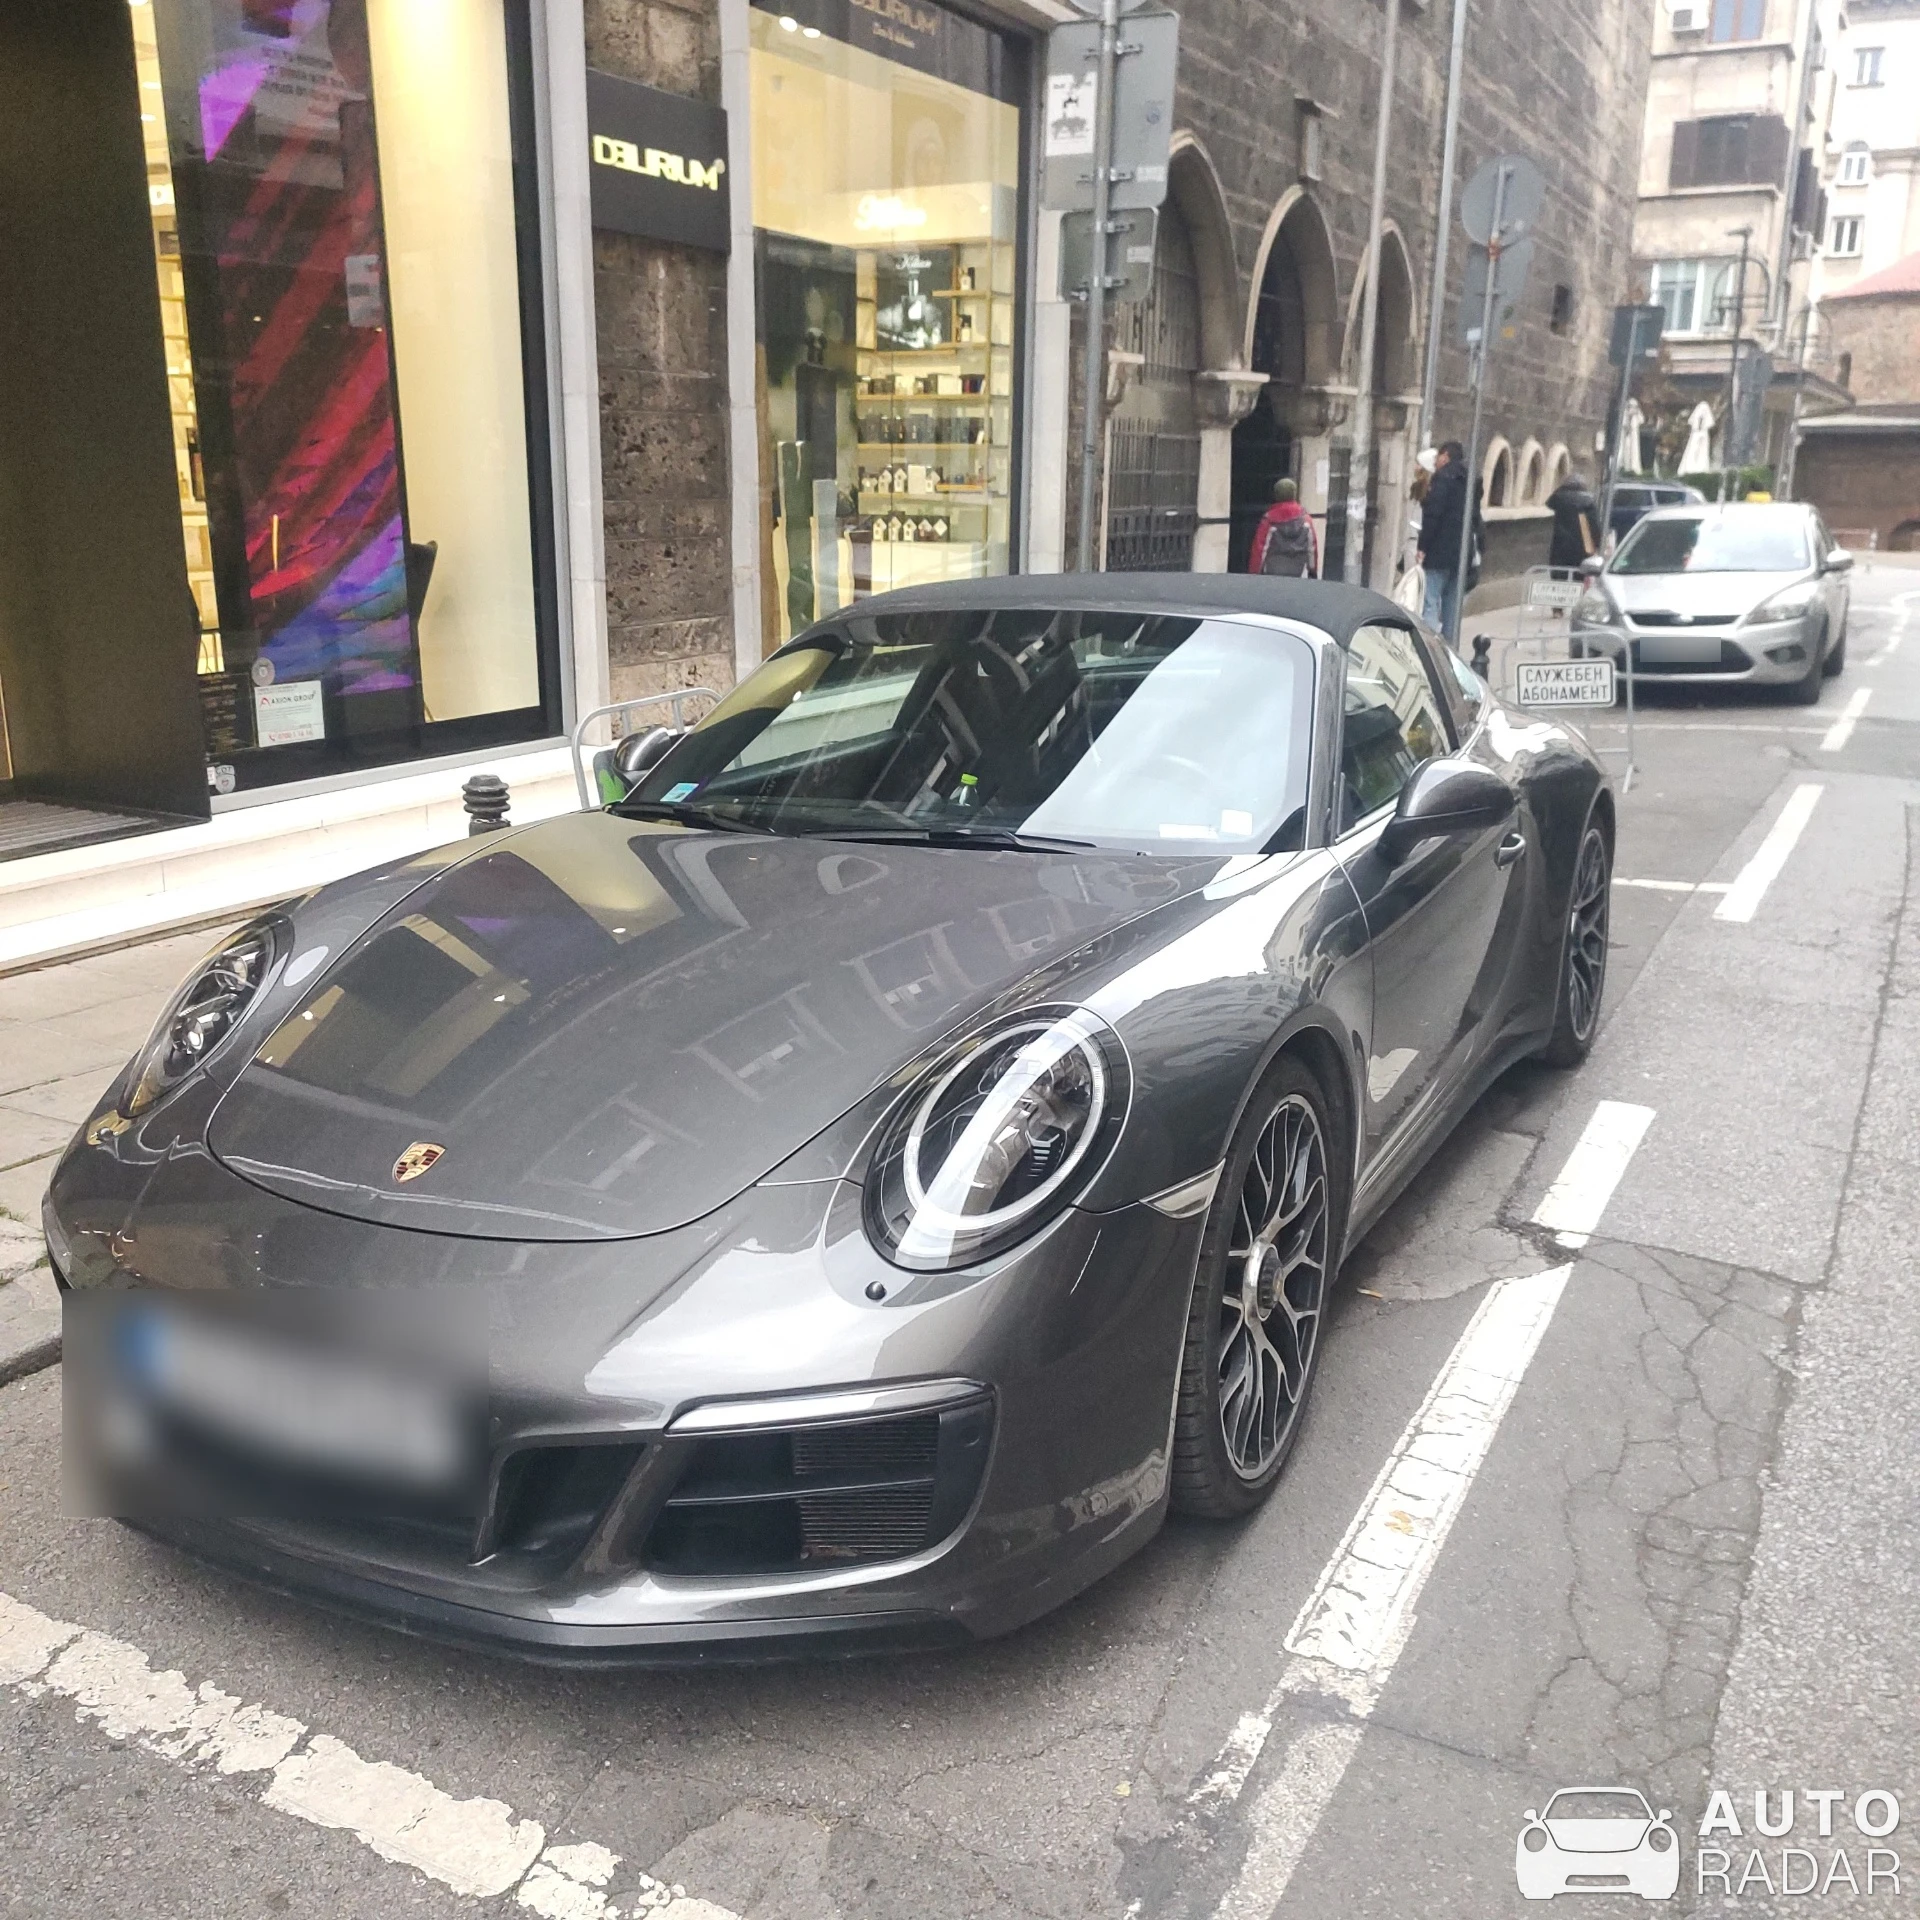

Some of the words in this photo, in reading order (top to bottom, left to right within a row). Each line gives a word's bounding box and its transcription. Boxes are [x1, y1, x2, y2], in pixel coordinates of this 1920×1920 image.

[849, 0, 938, 36] LIRIUM
[593, 134, 719, 191] DELIRIUM
[1525, 667, 1603, 683] СЛУЖЕБЕН
[271, 696, 292, 704] AXION
[293, 693, 315, 702] GROUP
[1522, 684, 1608, 701] АБОНАМЕНТ
